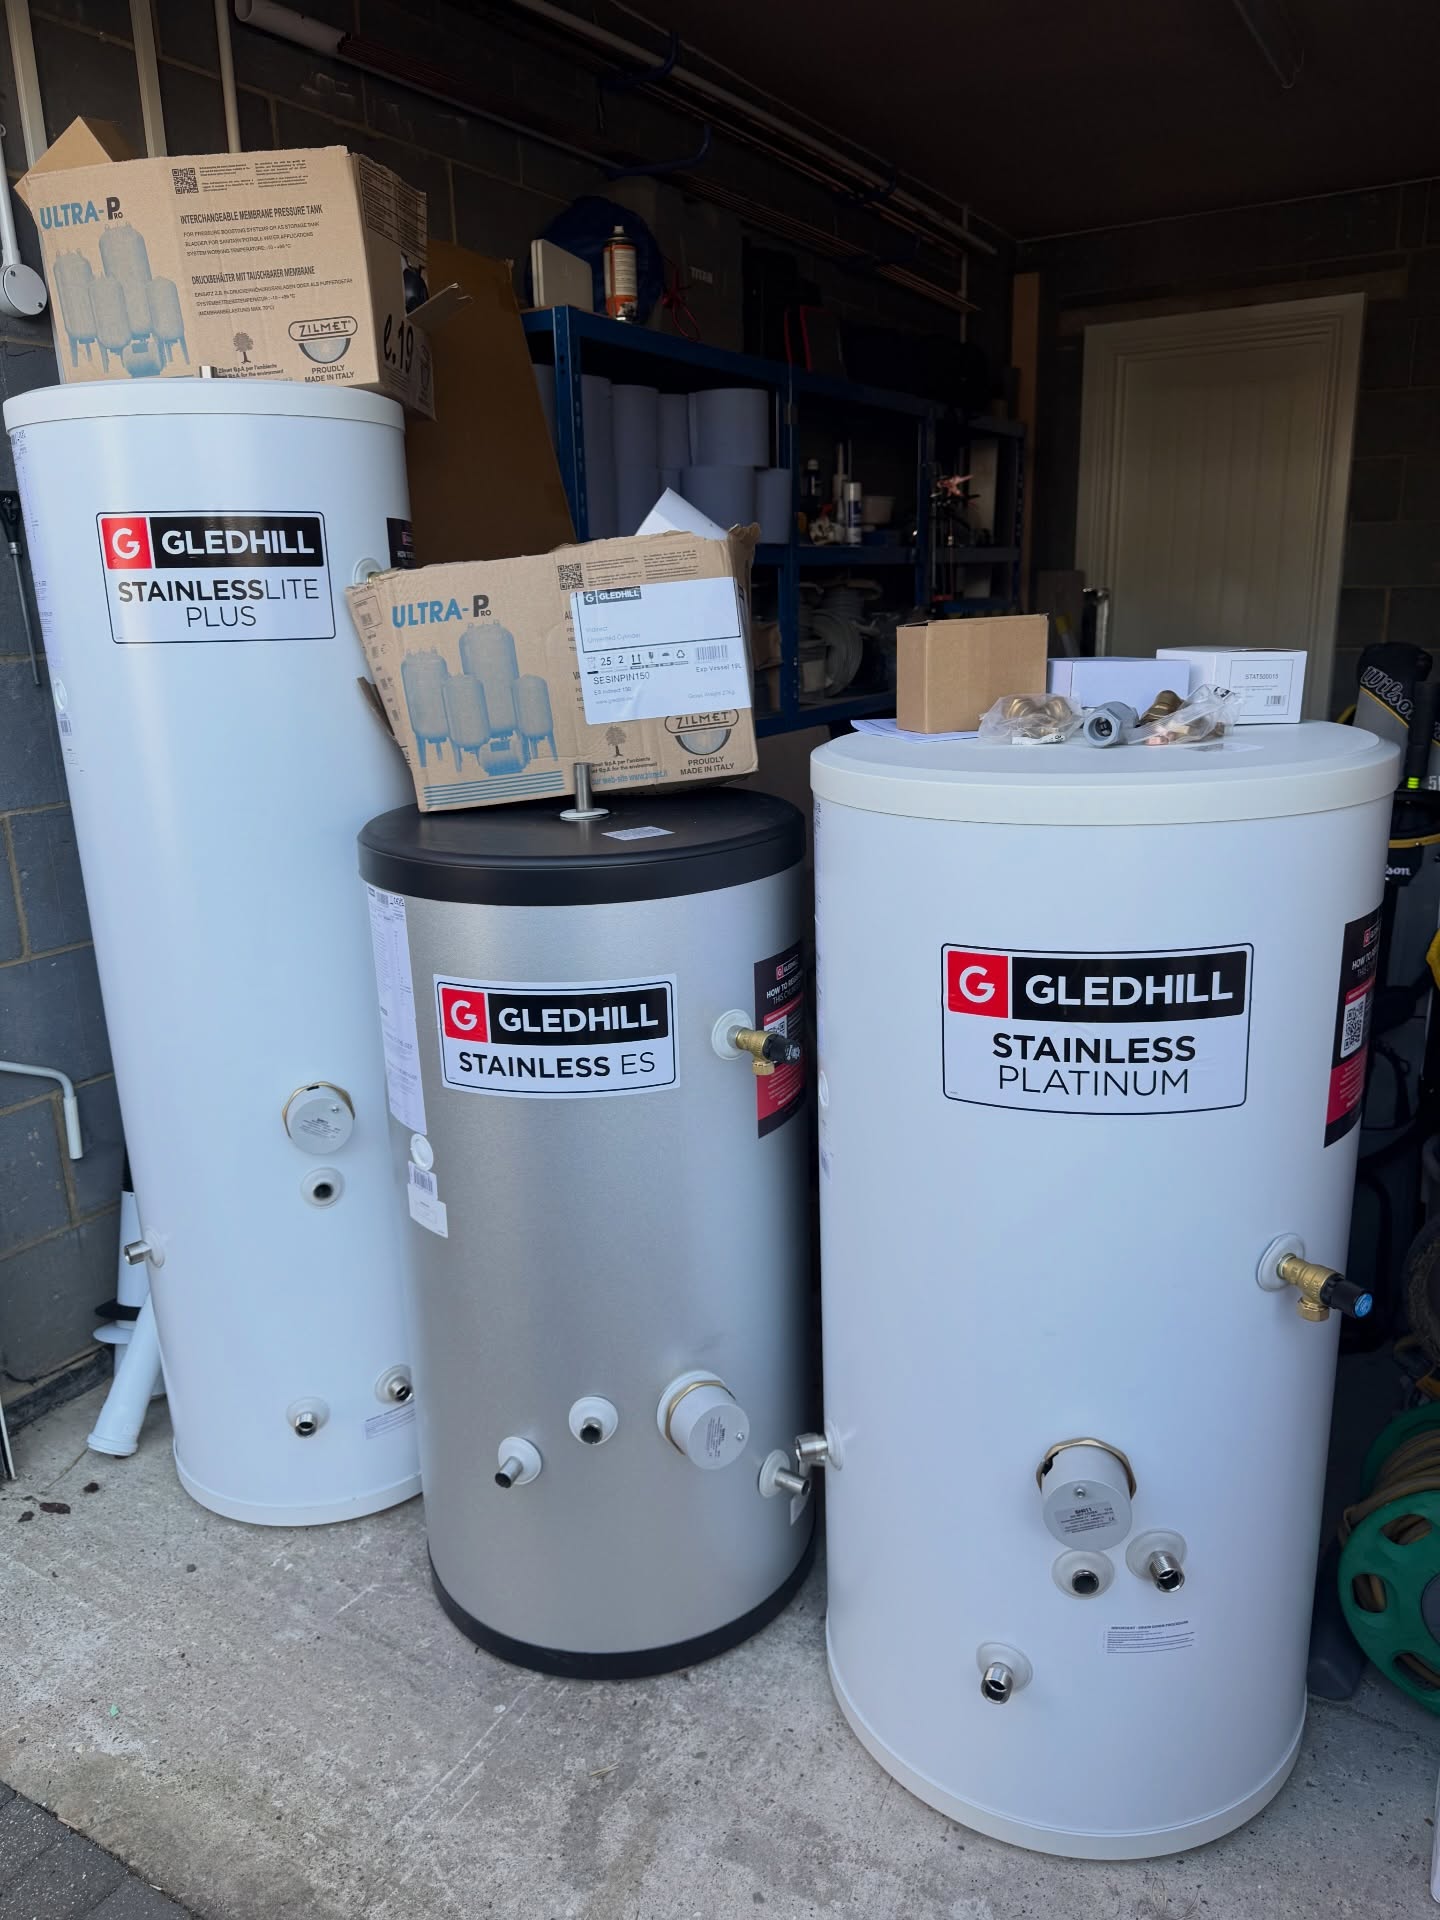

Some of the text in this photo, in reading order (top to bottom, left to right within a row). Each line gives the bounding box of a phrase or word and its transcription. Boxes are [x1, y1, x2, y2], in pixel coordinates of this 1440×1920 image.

[180, 203, 323, 224] INTERCHANGEABLE MEMBRANE PRESSURE TANK
[192, 266, 315, 285] DRUCKBEHÄLTER MIT TAUSCHBARER MEMBRANE
[298, 320, 348, 338] ZILMET
[304, 375, 326, 383] MADE
[335, 371, 355, 381] ITALY
[311, 364, 345, 374] PROUDLY
[112, 527, 315, 560] G GLEDHILL
[118, 578, 320, 602] STAINLESSLITE
[599, 589, 640, 601] GLEDHILL
[186, 605, 257, 628] PLUS
[600, 655, 624, 667] 25 2
[593, 671, 650, 685] SESINPIN150
[675, 711, 730, 730] ZILMET
[680, 767, 703, 776] MADE
[713, 762, 735, 772] ITALY
[687, 756, 725, 766] PROUDLY
[766, 985, 781, 999] HOW
[958, 964, 1233, 1007] G GLEDHILL
[451, 999, 659, 1033] G GLEDHILL
[992, 1031, 1197, 1064] STAINLESS
[459, 1051, 656, 1078] STAINLESS ES
[999, 1064, 1189, 1097] PLATINUM
